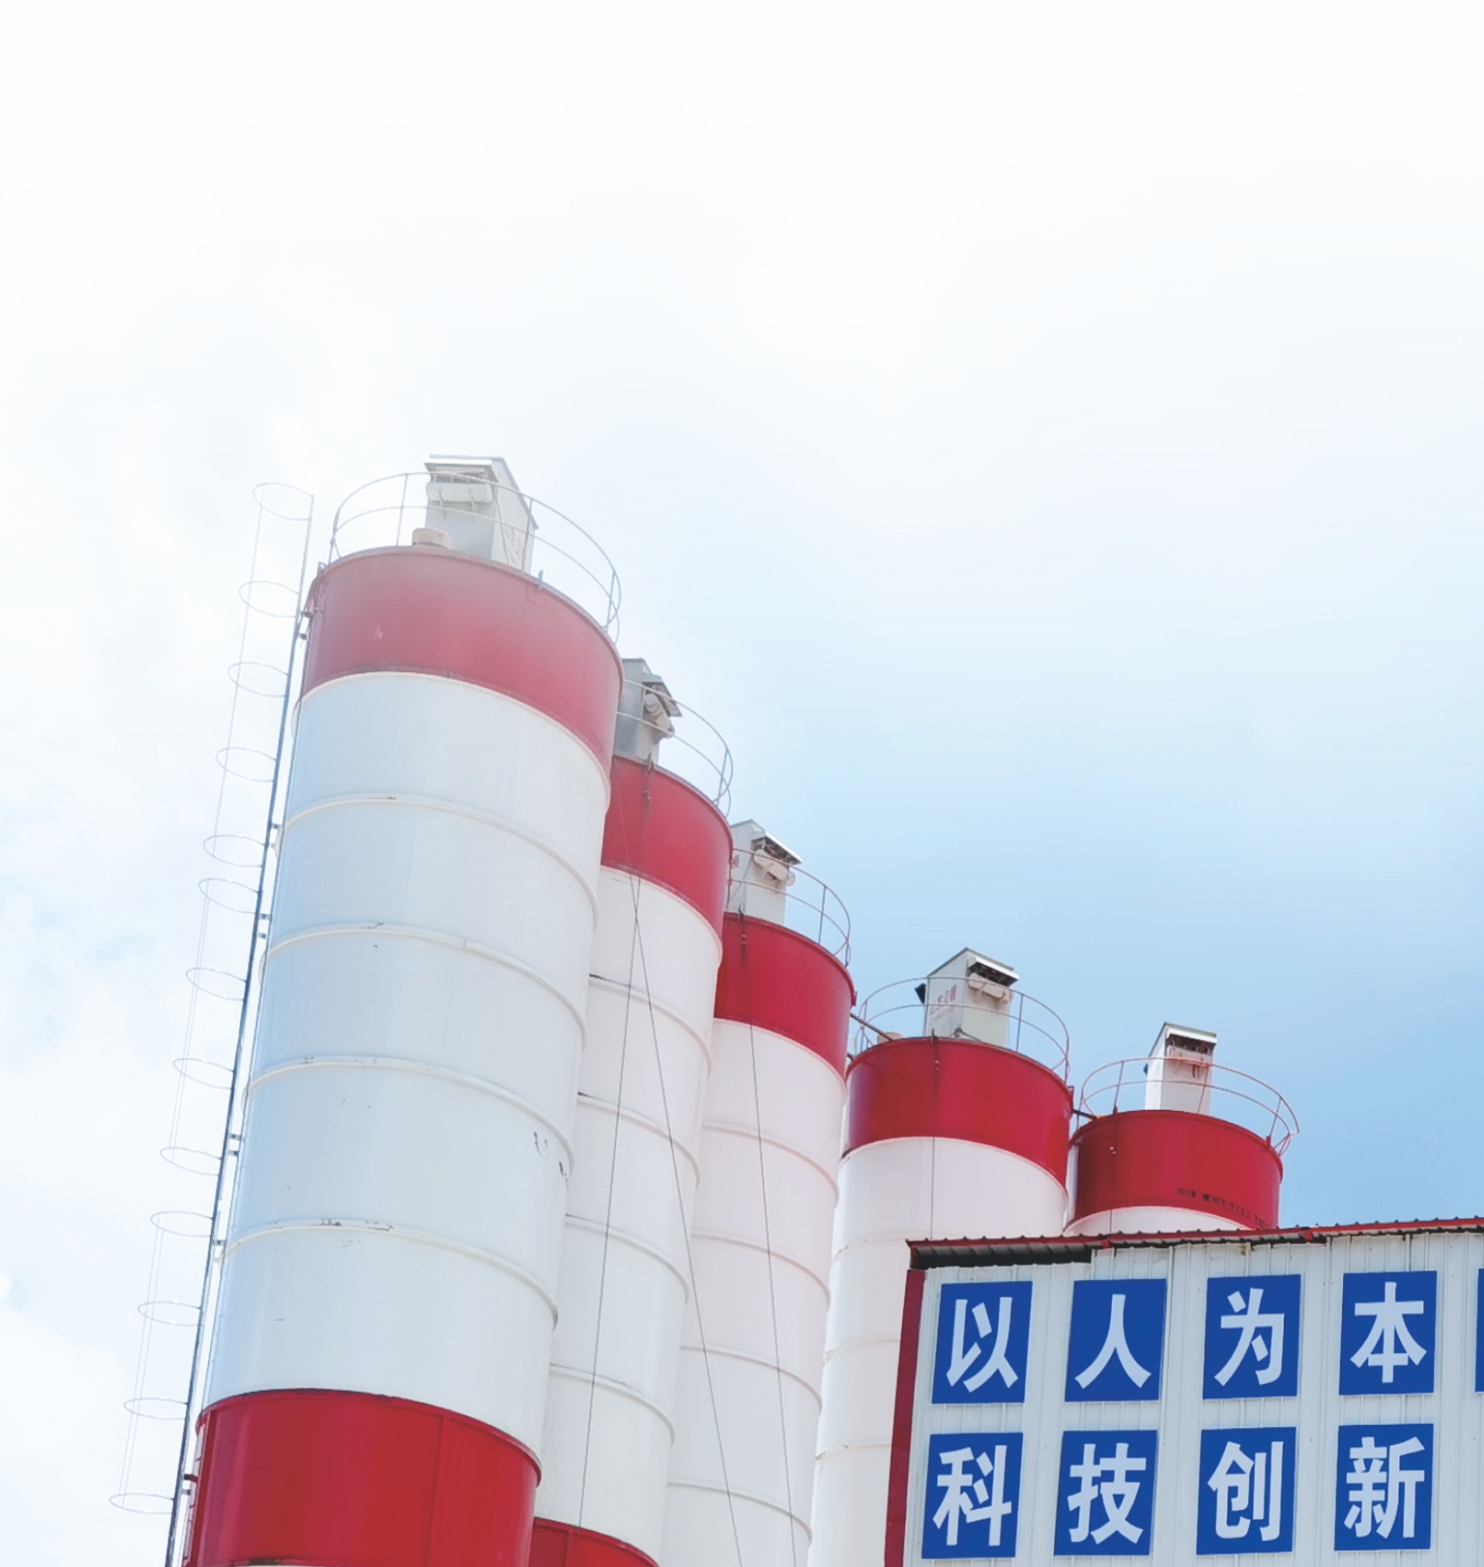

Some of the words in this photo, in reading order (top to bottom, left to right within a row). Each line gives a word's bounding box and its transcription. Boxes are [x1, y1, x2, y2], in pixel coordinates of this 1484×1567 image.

[945, 1281, 1428, 1392] 以人为本
[933, 1435, 1426, 1546] 科技创新
